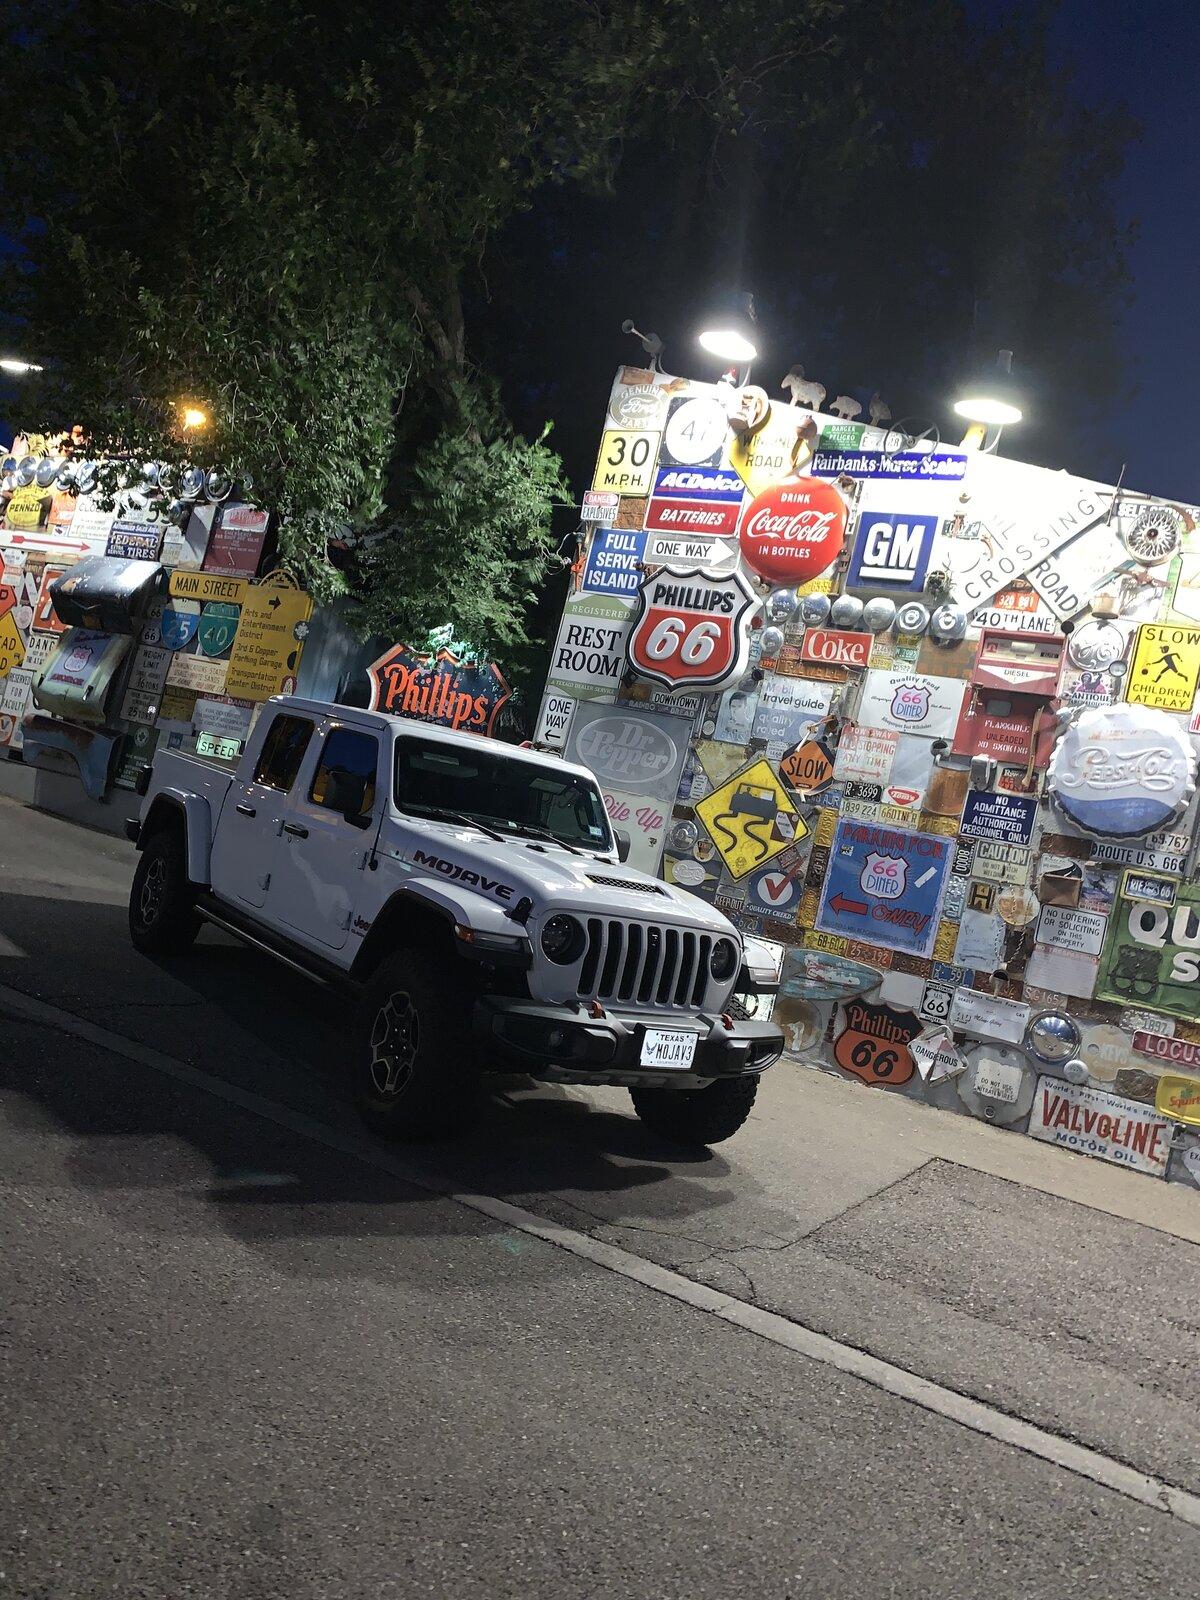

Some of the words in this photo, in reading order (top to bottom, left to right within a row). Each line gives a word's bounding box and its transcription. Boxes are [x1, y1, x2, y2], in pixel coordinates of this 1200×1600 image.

[607, 437, 650, 467] 30
[746, 455, 784, 468] ROAD
[604, 473, 644, 487] M.P.H.
[660, 471, 744, 492] ACDelco
[780, 493, 811, 504] DRINK
[659, 508, 726, 526] BATTERIES
[605, 534, 637, 551] FULL
[656, 542, 681, 556] ONE
[685, 544, 712, 558] WAY
[862, 522, 926, 569] GM
[965, 498, 1095, 600] CROSSING
[127, 548, 155, 559] TIRES
[758, 545, 770, 555] IN
[772, 547, 811, 558] BOTTLES
[596, 552, 639, 571] SERVE
[174, 577, 201, 593] MAIN
[203, 581, 241, 598] STREET
[587, 570, 638, 590] ISLAND
[652, 582, 736, 612] PHILLIPS
[1035, 561, 1080, 617] ROAD
[571, 605, 631, 619] REGISTERED
[1020, 615, 1051, 632] LANE
[204, 626, 229, 646] 40
[565, 624, 623, 651] REST
[645, 616, 722, 666] 66
[1145, 628, 1200, 646] SLOW
[807, 631, 865, 663] Coke
[555, 648, 622, 678] ROOM
[1003, 669, 1031, 678] DIESEL
[11, 685, 23, 695] FOR
[889, 675, 920, 685] Quality
[922, 678, 941, 692] Food
[1132, 684, 1191, 699] CHILDREN
[384, 662, 490, 731] Phillips
[654, 693, 698, 708] DOWNTOWN
[763, 693, 793, 705] travel
[794, 698, 825, 710] guide
[901, 692, 922, 704] 66
[1133, 695, 1147, 704] AT
[1154, 697, 1187, 709] PLAY
[548, 698, 572, 715] ONE
[670, 707, 695, 718] BREAD
[895, 703, 923, 719] DINER
[545, 714, 568, 729] WAY
[984, 719, 1031, 734] FLAMMABLE
[620, 722, 656, 750] Dr
[985, 732, 1025, 746] UNLEADED
[200, 742, 235, 758] SPEED
[588, 729, 670, 774] Pepper
[858, 739, 896, 756] STOPPING
[977, 740, 989, 750] NO
[992, 743, 1028, 755] SMOKING
[786, 756, 828, 781] SLOW
[843, 753, 860, 764] ANY
[866, 757, 887, 769] TIME
[857, 786, 879, 799] 3699
[995, 795, 1009, 806] NO
[861, 805, 878, 817] 224
[972, 801, 1028, 820] ADMITTANCE
[635, 807, 663, 833] Up
[972, 815, 1022, 833] AUTHORIZED
[843, 823, 906, 852] PARKING
[908, 837, 944, 859] FOR
[961, 824, 1005, 841] PERSONNEL
[1007, 831, 1030, 845] ONLY
[978, 842, 1028, 866] CAUTION
[1098, 846, 1134, 864] ROUTE
[1136, 852, 1158, 868] U.S.
[1163, 857, 1179, 872] 66
[413, 849, 516, 901] MOJAVE
[872, 861, 898, 877] 66
[866, 874, 899, 895] DINER
[749, 905, 772, 915] QUALITY
[1046, 908, 1058, 919] NO
[1060, 911, 1101, 927] LOITERING
[872, 903, 932, 938] ONLY
[1044, 917, 1055, 927] OR
[1058, 920, 1101, 936] SOLICITING
[1052, 936, 1085, 949] PROPERTY
[1068, 931, 1083, 941] THIS
[871, 949, 890, 965] 192
[926, 1001, 946, 1014] 66
[847, 1005, 911, 1045] Phillips
[660, 1033, 684, 1043] TEXAS
[850, 1039, 900, 1078] 66
[915, 1045, 960, 1067] DANGEROUS
[981, 1077, 989, 1085] DO
[990, 1079, 1002, 1088] NOT
[1044, 1081, 1075, 1096] World's
[1079, 1088, 1100, 1102] First
[1107, 1099, 1138, 1115] World's
[1042, 1088, 1168, 1165] VALVOLINE
[1056, 1131, 1108, 1155] MOTOR
[1113, 1148, 1137, 1165] OIL
